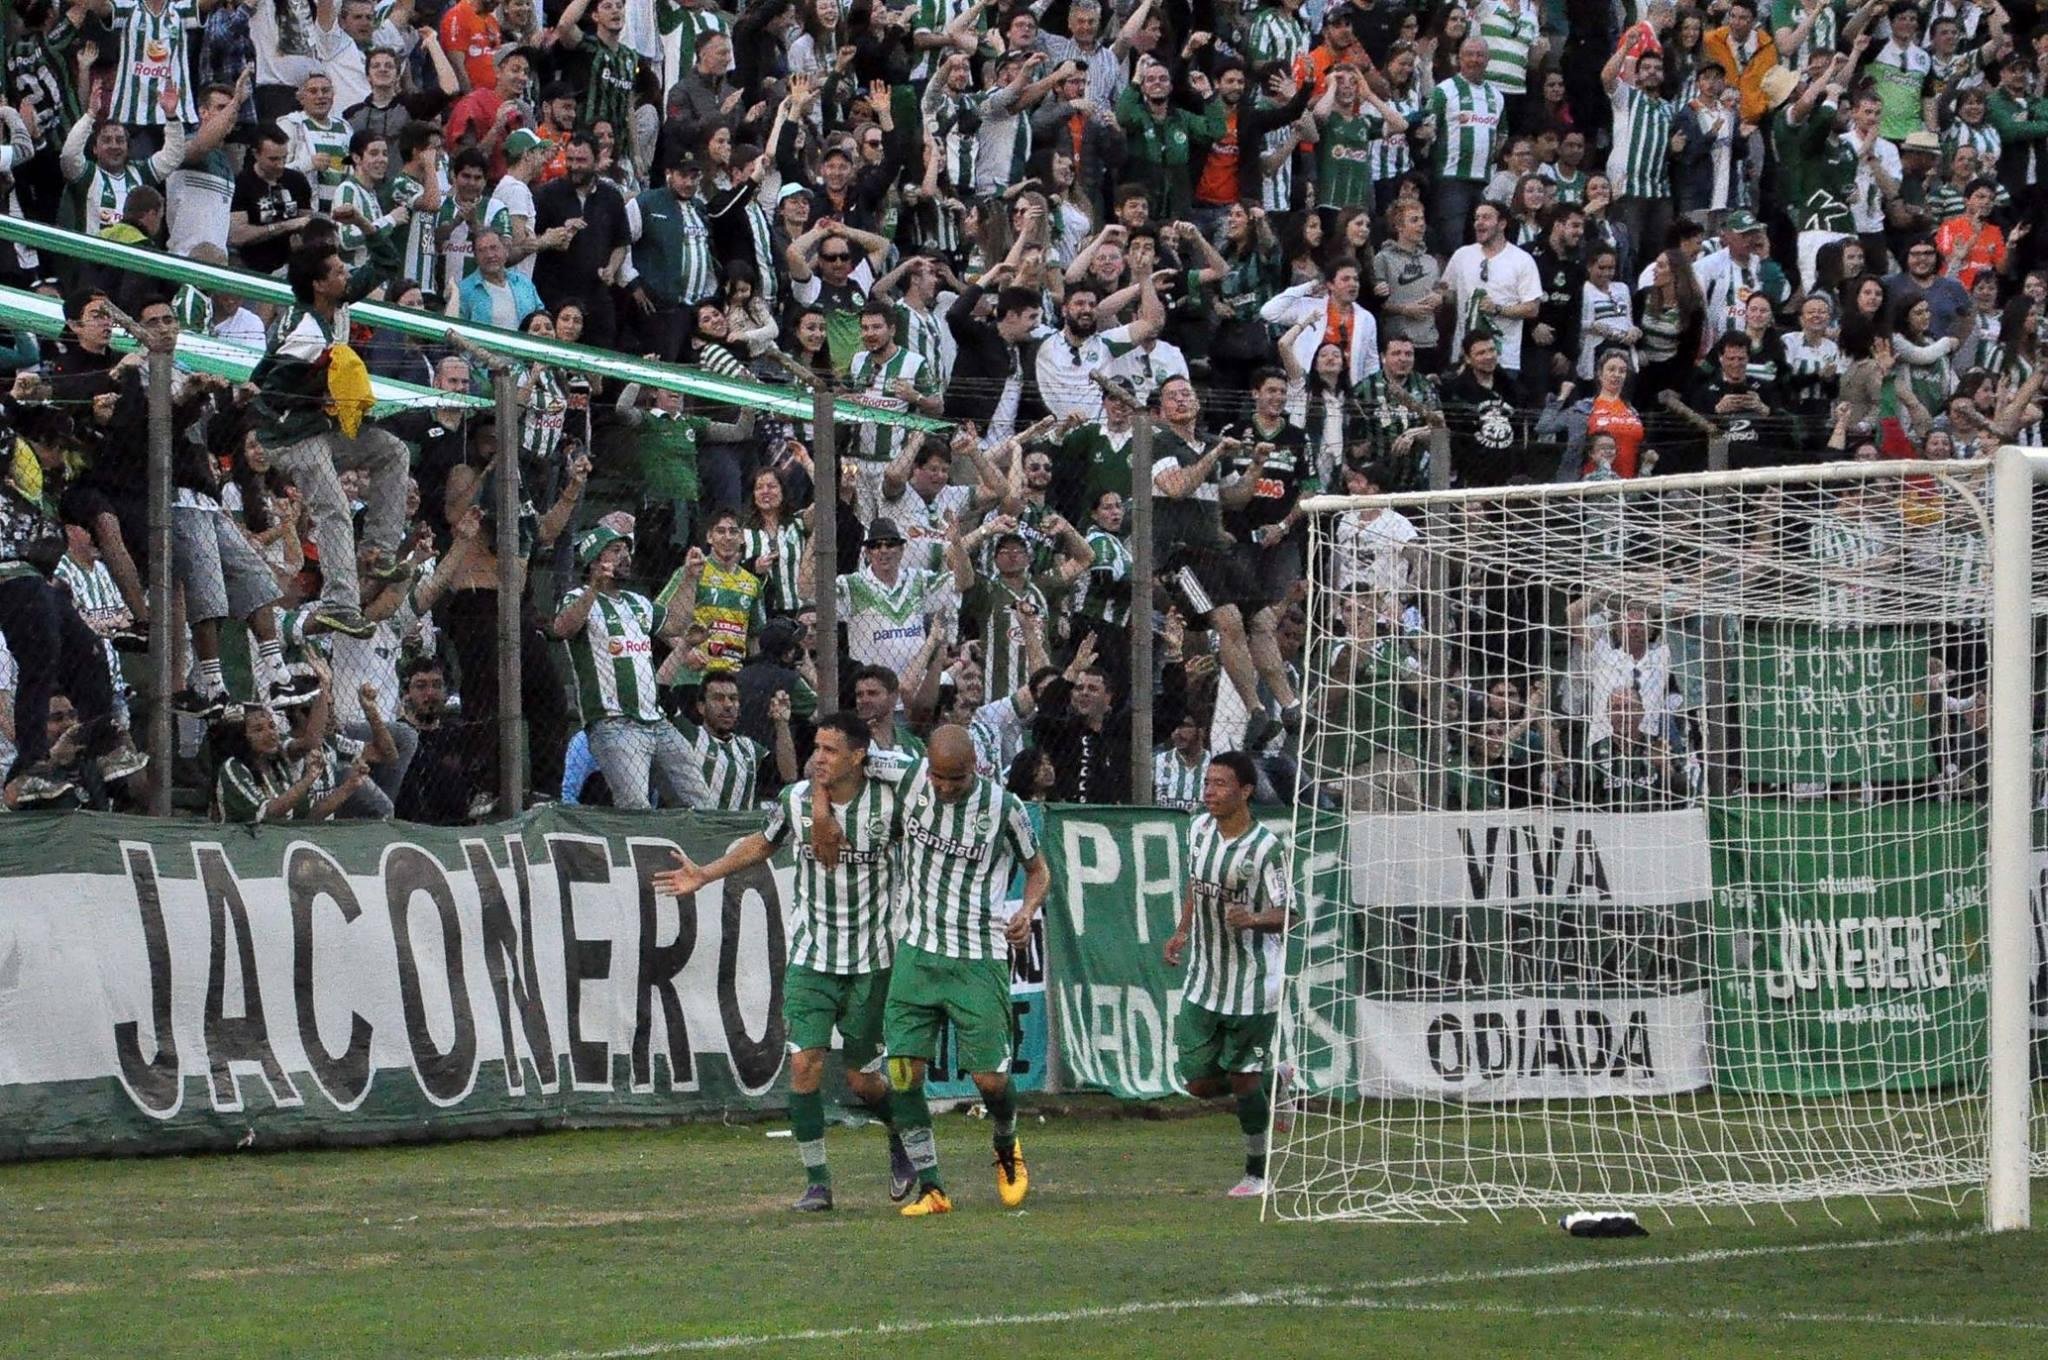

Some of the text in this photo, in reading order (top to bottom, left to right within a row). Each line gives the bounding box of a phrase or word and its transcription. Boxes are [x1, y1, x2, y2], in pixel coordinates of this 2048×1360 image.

[801, 845, 880, 865] Brisul
[907, 816, 988, 862] Banrisul
[1457, 825, 1612, 900] VIVA
[113, 832, 788, 1119] JACONERO
[1399, 912, 1489, 998] LA
[1767, 908, 1950, 1000] JUVEBERG
[1427, 1008, 1655, 1082] ODIADA
